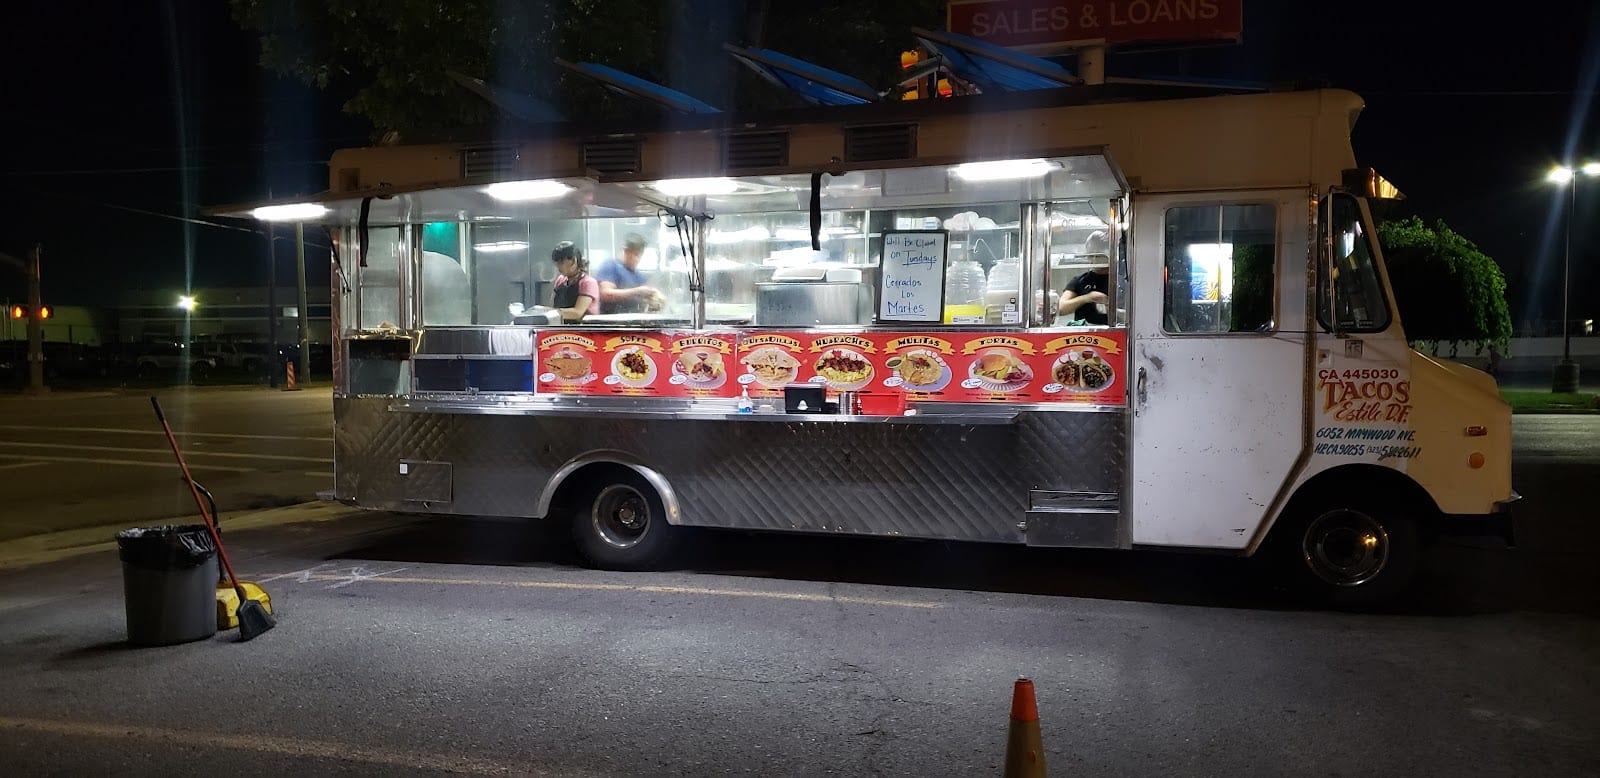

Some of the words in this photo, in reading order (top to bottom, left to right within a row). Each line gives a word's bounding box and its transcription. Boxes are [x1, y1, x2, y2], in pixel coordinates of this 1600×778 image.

[971, 6, 1069, 38] SALES
[1080, 4, 1100, 28] &
[1110, 0, 1219, 26] LOANS
[886, 237, 900, 245] Will
[886, 274, 922, 288] Cerrados
[901, 290, 915, 298] Los
[887, 301, 925, 314] Martes
[620, 334, 647, 344] SOPES
[678, 337, 723, 348] BURRITOS
[742, 336, 799, 347] QUESADILLAS
[815, 335, 870, 348] HUARACHES
[898, 336, 940, 347] MULITAS
[979, 337, 1019, 346] TORTAS
[1064, 335, 1100, 345] TACOS
[1318, 369, 1339, 380] CA
[1342, 369, 1399, 380] 445030
[1318, 379, 1412, 411] TACOS
[1316, 427, 1344, 439] 6052
[1344, 428, 1396, 441] MAYWOOD
